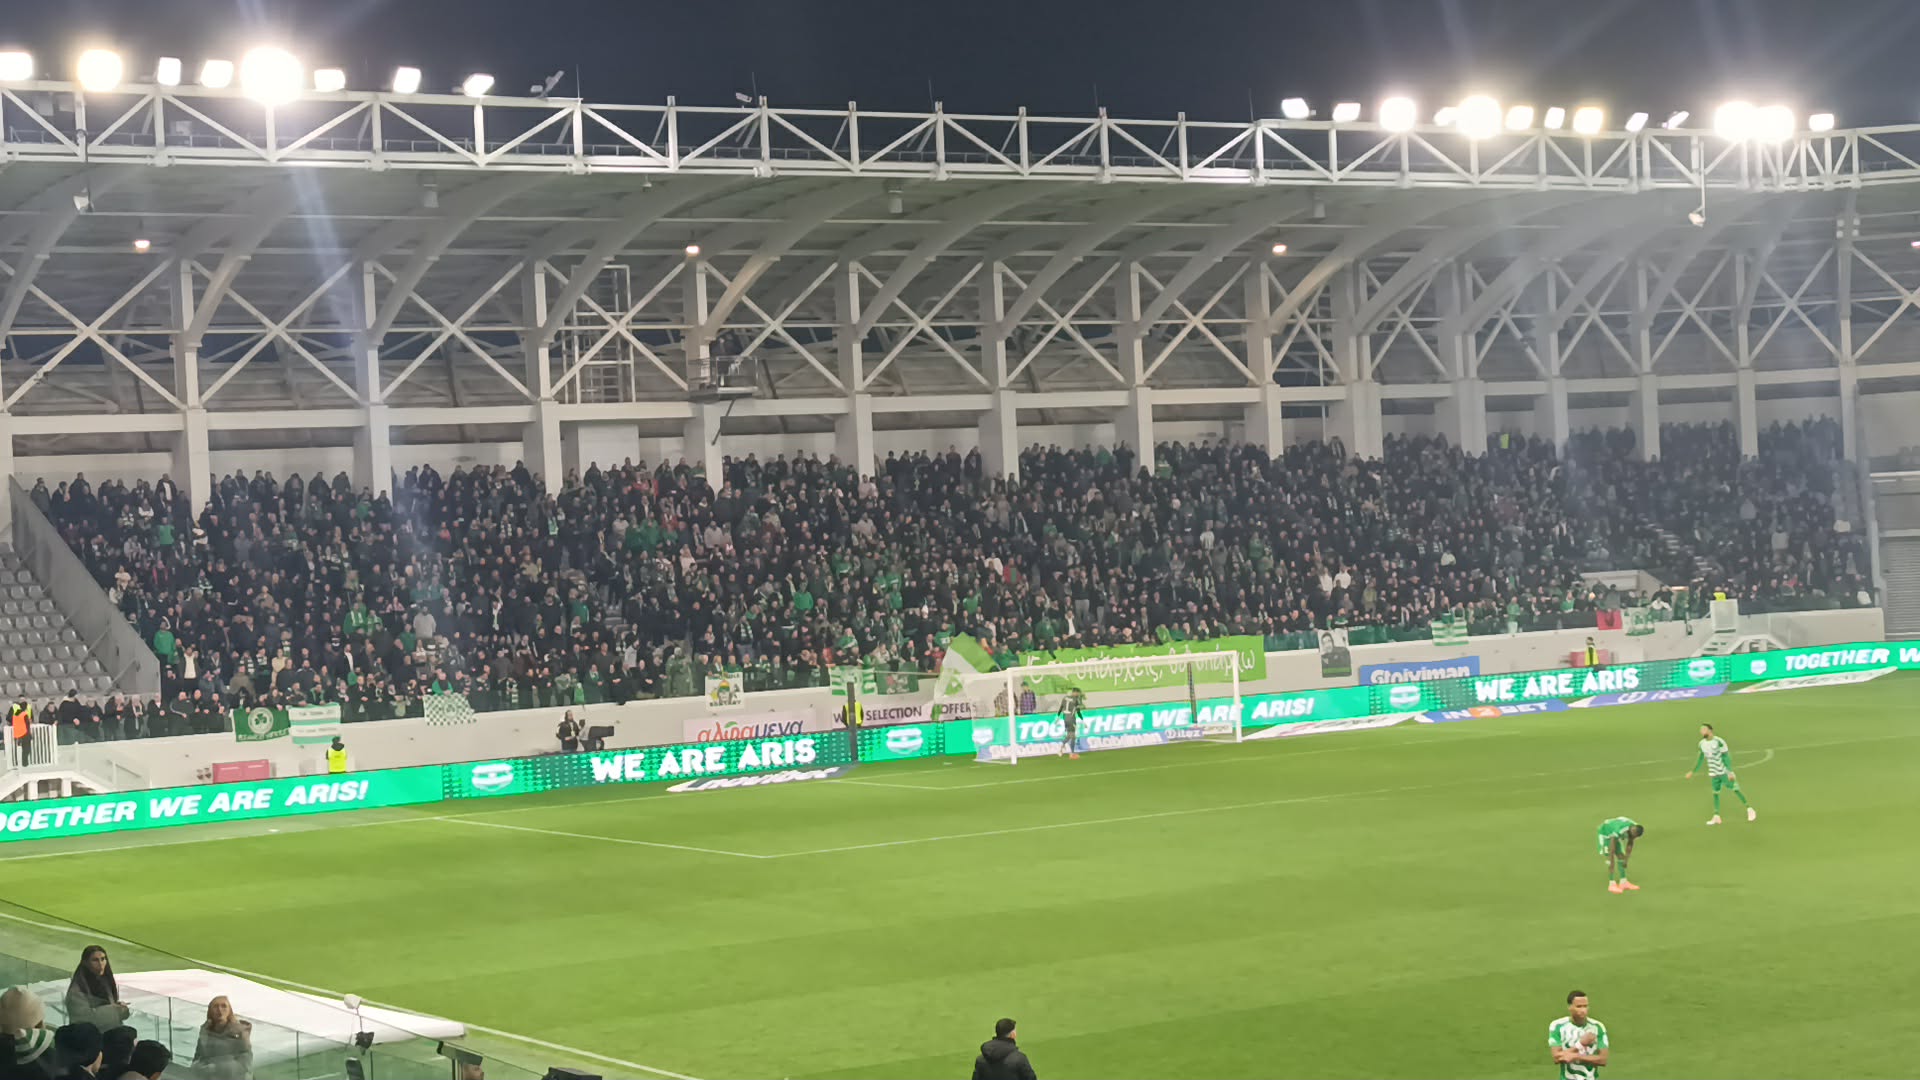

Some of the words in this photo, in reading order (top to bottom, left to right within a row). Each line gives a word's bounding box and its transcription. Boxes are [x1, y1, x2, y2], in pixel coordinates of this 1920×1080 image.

[1784, 648, 1891, 671] TOGETHER
[1475, 678, 1516, 703] WE
[1523, 673, 1574, 697] ARE
[1581, 667, 1640, 692] ARIS
[866, 706, 922, 721] SELECTION
[1151, 704, 1192, 728] WE
[1251, 697, 1315, 720] ARIS!
[591, 753, 645, 782] WE
[658, 744, 726, 776] ARE
[738, 737, 818, 770] ARIS
[0, 800, 137, 833] GETHER
[149, 794, 201, 818] WE
[208, 789, 272, 813] ARE
[285, 780, 369, 806] ARIS!
